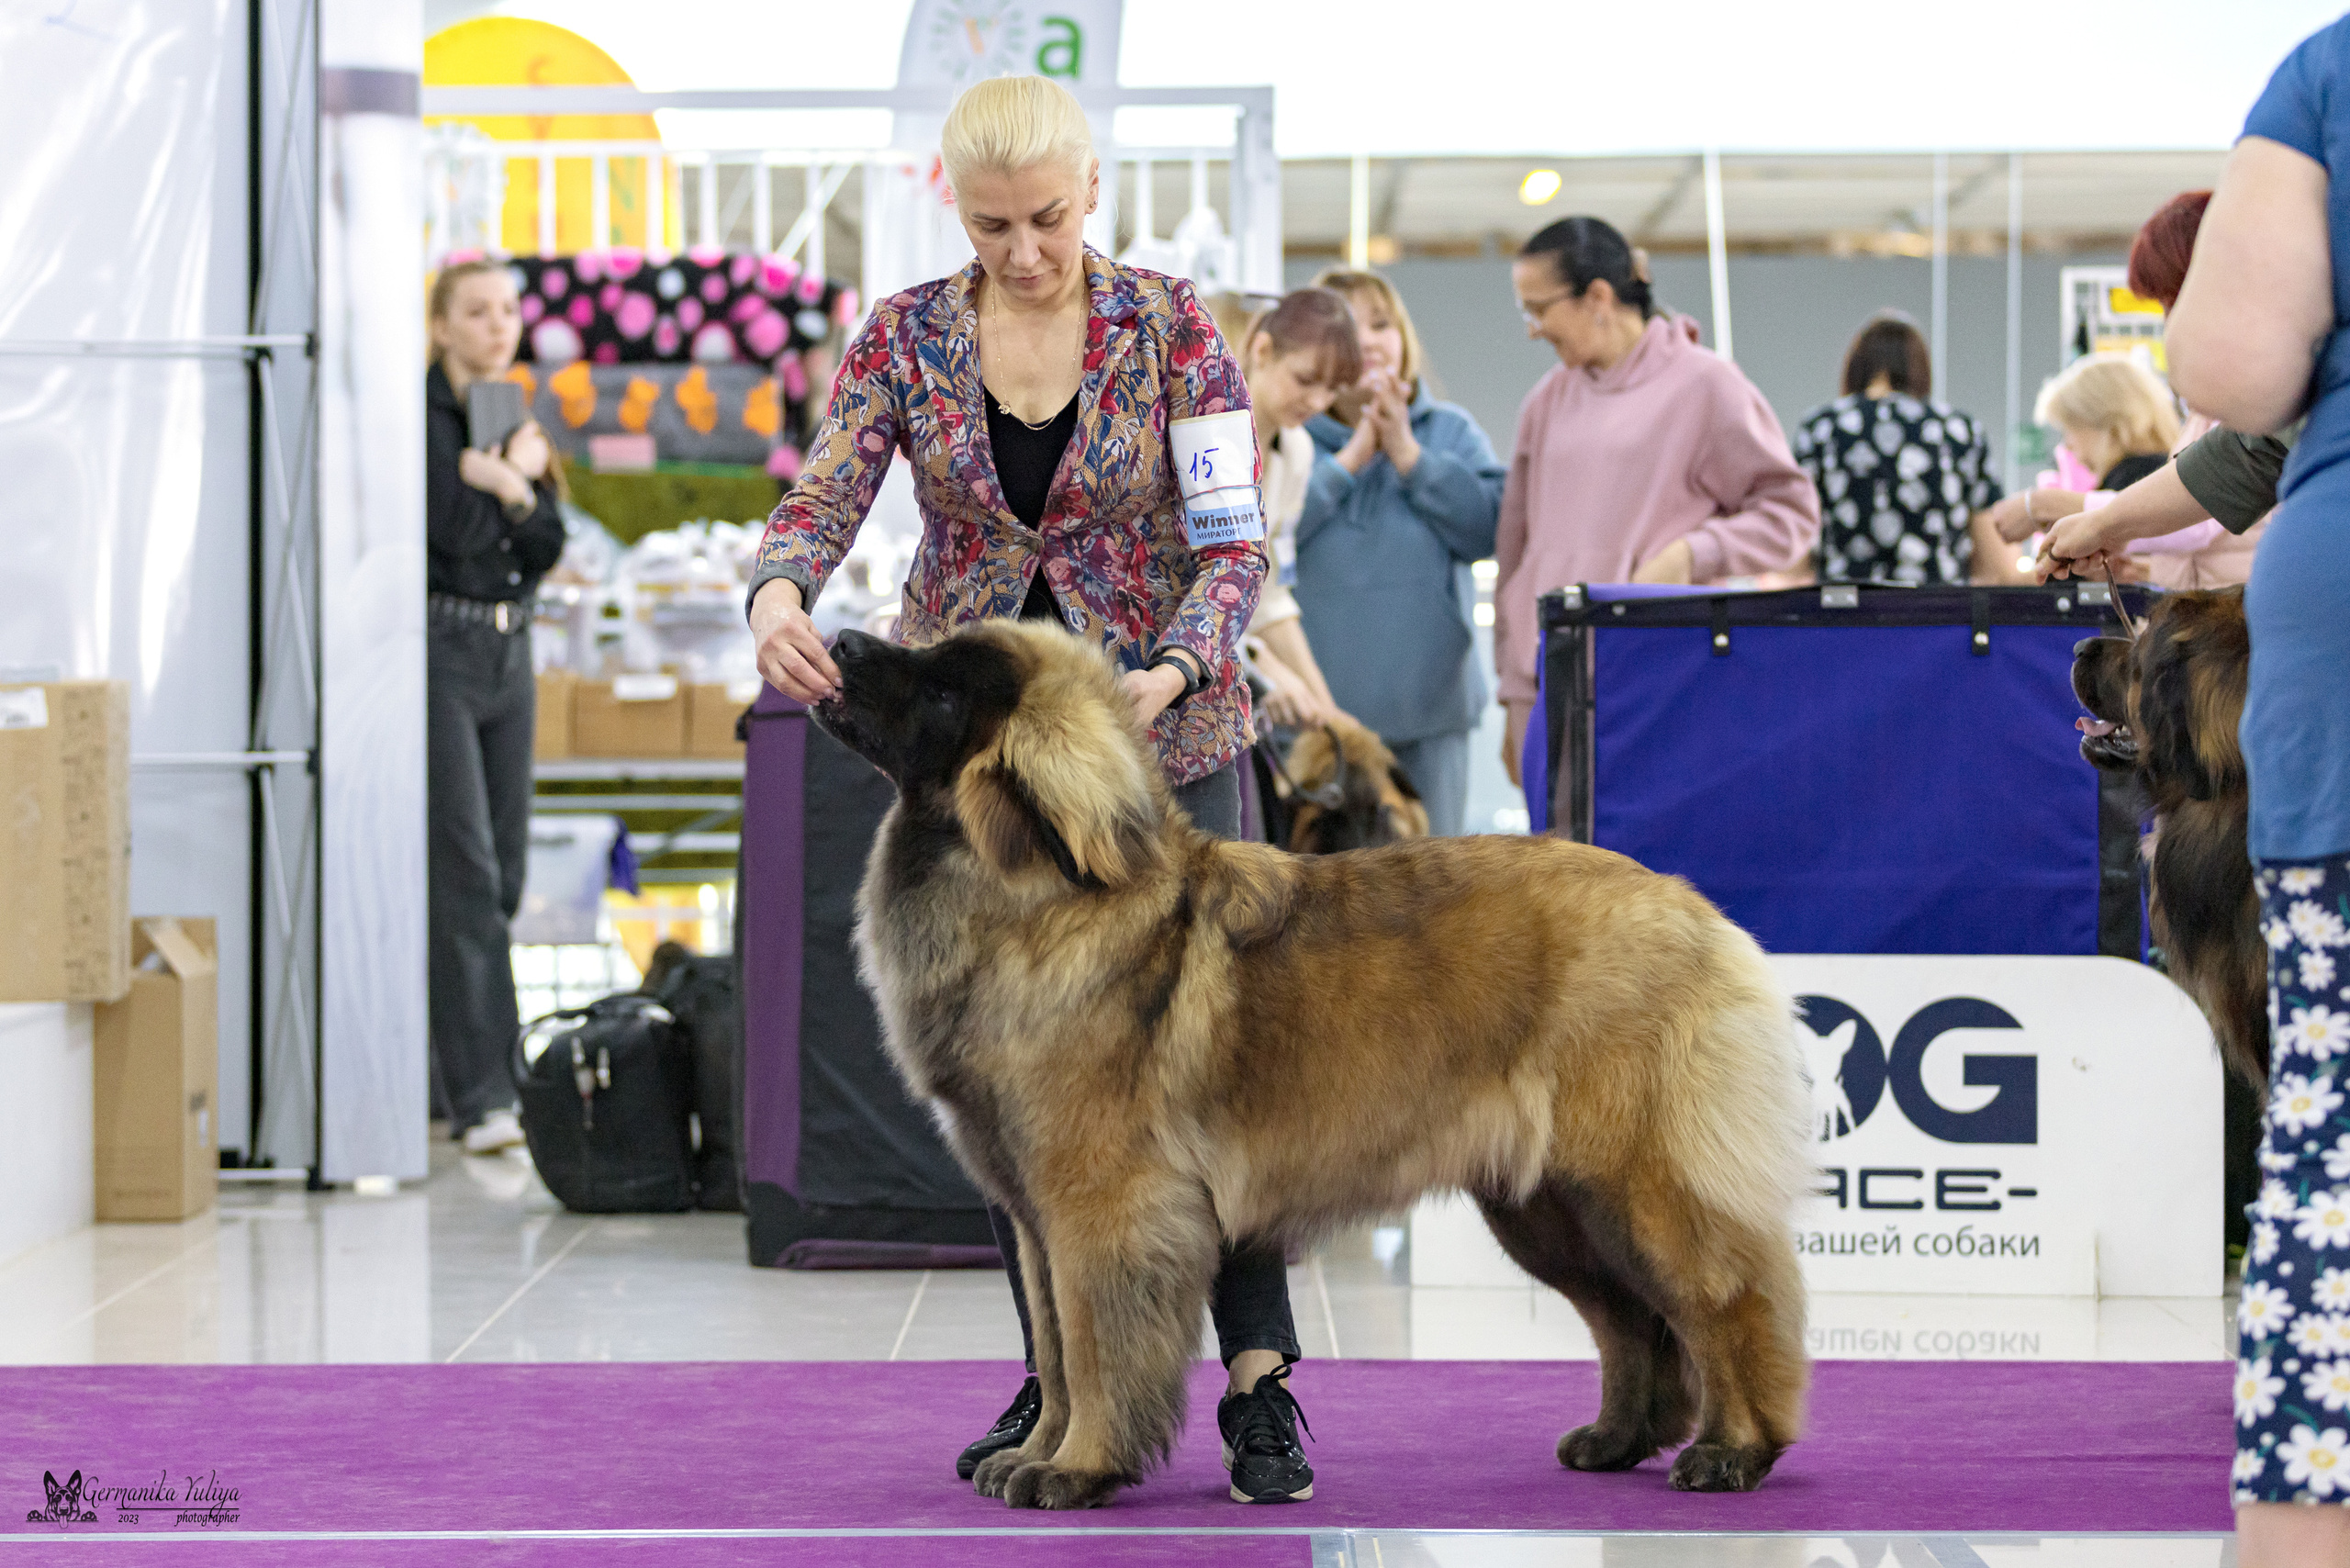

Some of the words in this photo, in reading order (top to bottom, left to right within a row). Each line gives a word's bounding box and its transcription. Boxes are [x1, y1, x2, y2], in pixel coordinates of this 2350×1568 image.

[1189, 448, 1220, 482] 15
[1192, 512, 1255, 530] Winner
[1913, 1225, 2041, 1256] собаки
